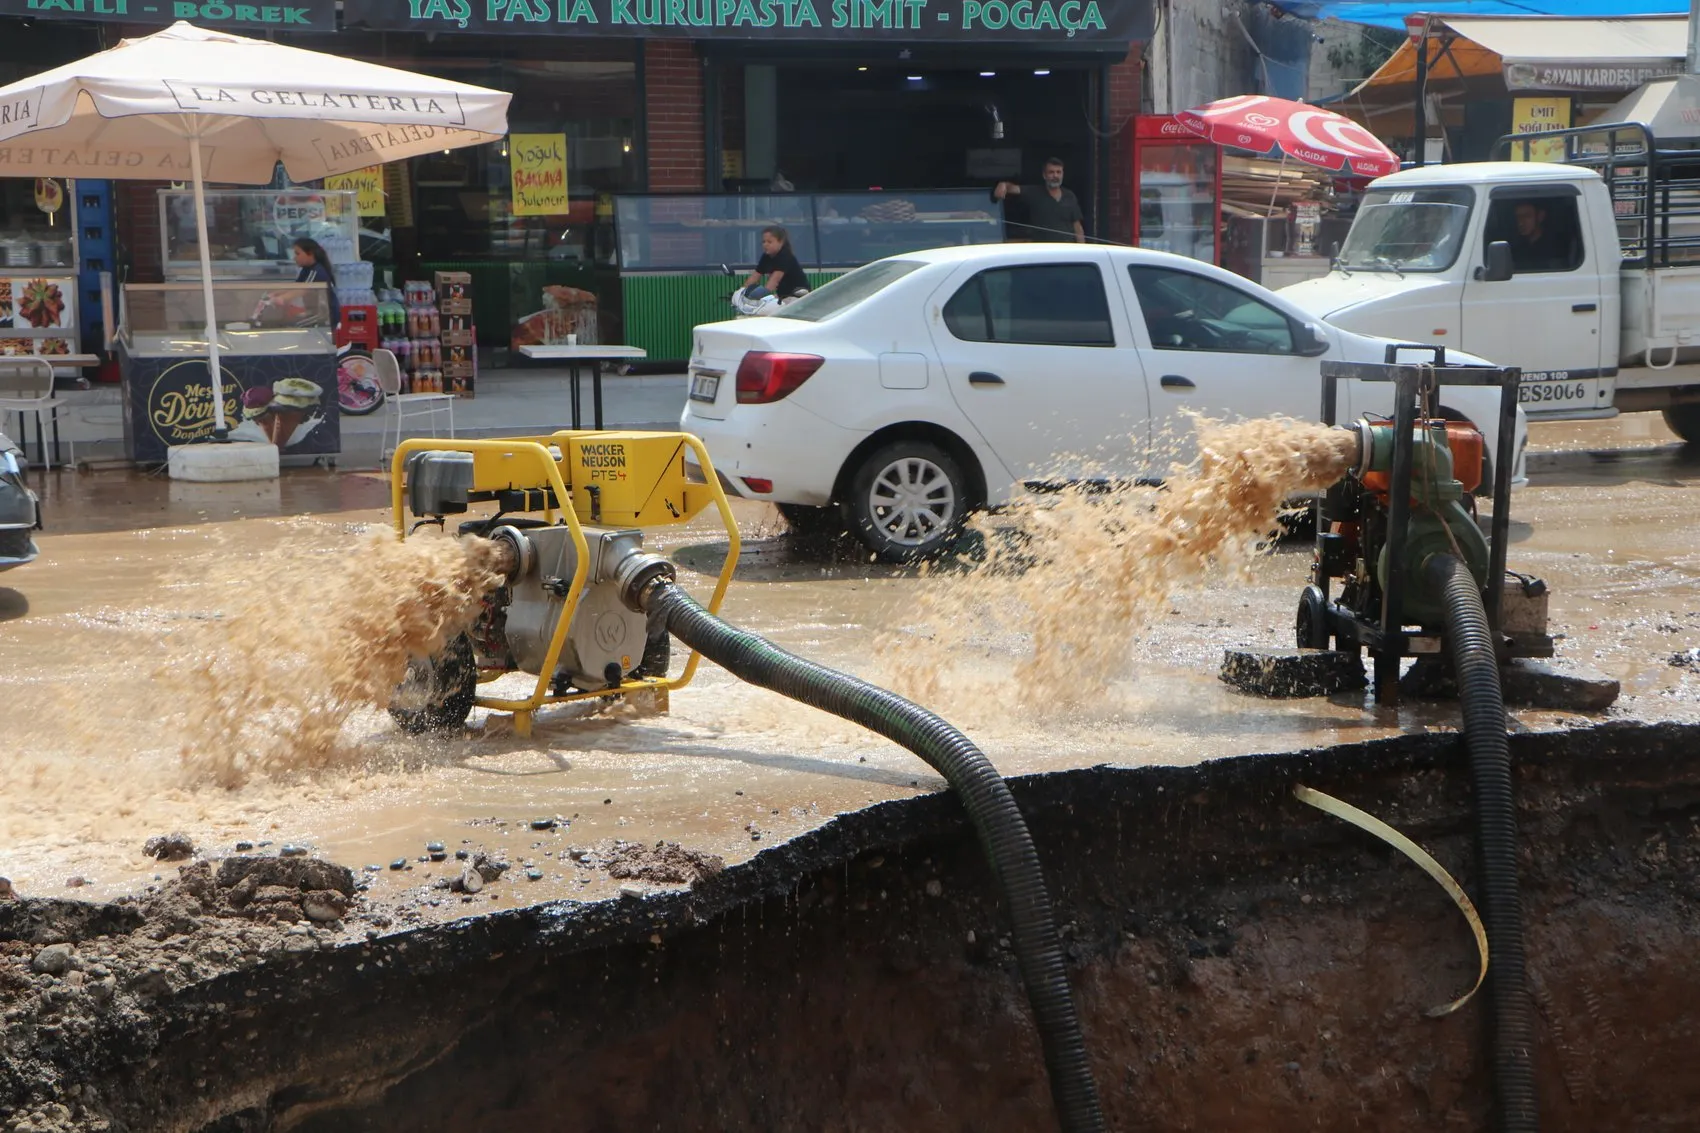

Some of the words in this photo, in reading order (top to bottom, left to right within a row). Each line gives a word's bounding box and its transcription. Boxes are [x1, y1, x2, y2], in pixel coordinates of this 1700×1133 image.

[174, 0, 312, 24] BÖREK
[408, 0, 472, 28] YAŞ
[486, 0, 599, 24] PASTA
[611, 0, 822, 28] KURUPASTA
[1541, 69, 1581, 86] SAYAN
[191, 87, 237, 102] LA
[250, 90, 446, 114] GELATERIA
[1550, 372, 1568, 380] 100
[184, 383, 238, 399] Meşur
[581, 444, 625, 456] WACKER
[582, 456, 626, 467] NEUSON
[592, 470, 627, 481] PTS4
